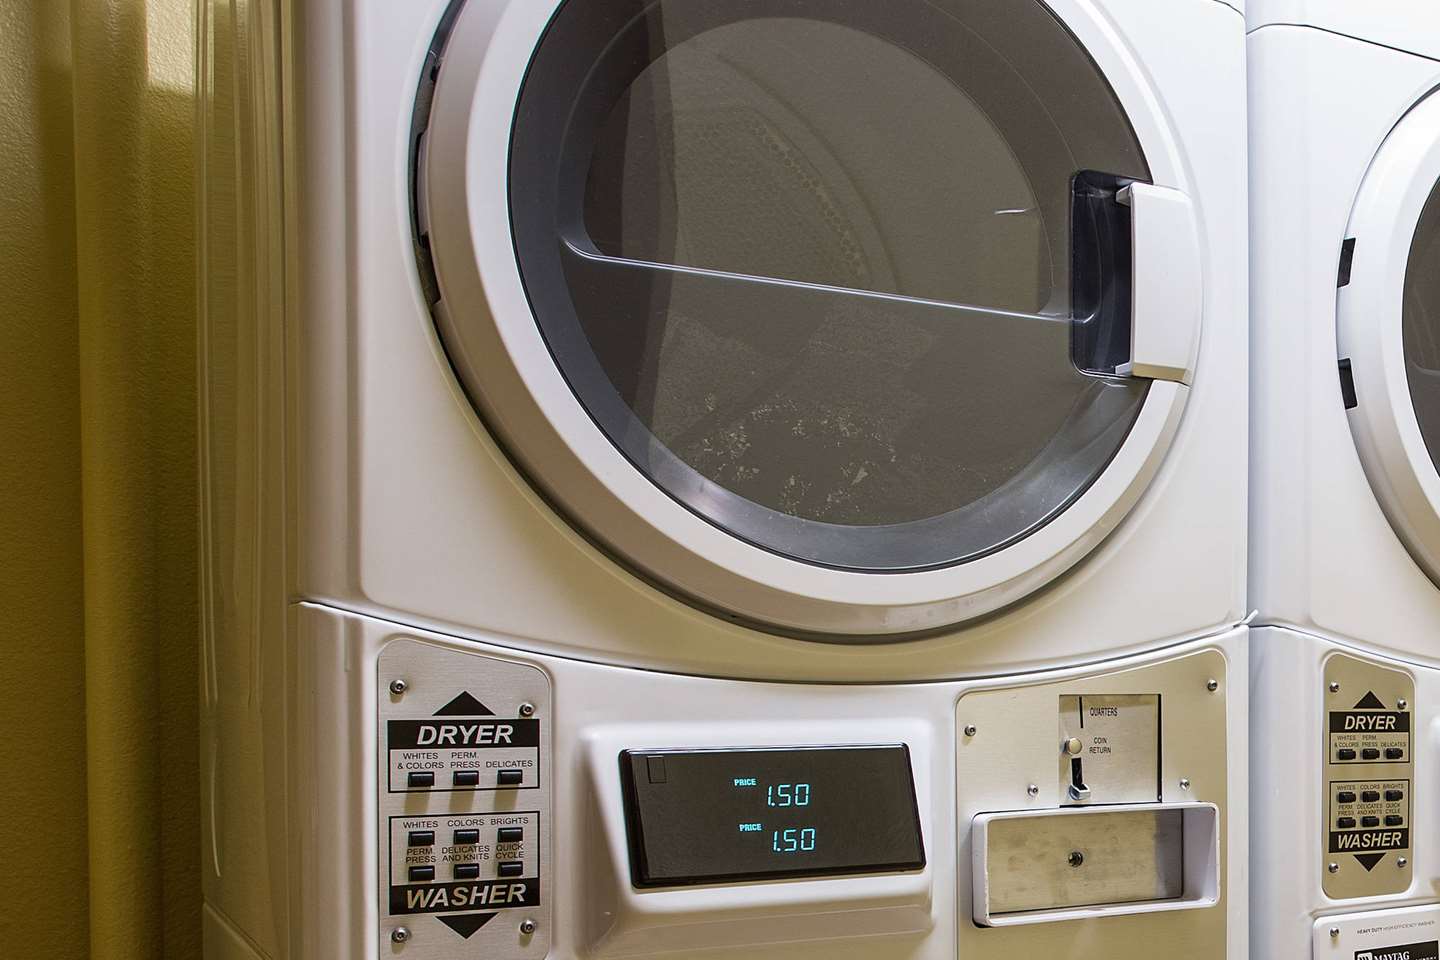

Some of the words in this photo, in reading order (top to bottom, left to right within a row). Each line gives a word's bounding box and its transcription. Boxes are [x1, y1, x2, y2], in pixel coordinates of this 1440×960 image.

[1090, 707, 1118, 716] QUARTERS
[1344, 715, 1396, 730] DRYER
[417, 725, 513, 745] DRYER
[403, 752, 439, 760] WHITES
[486, 760, 533, 768] DELICATES
[734, 778, 757, 786] PRICE
[767, 783, 810, 807] 1.50
[403, 821, 439, 829] WHITES
[447, 819, 485, 827] COLORS
[490, 817, 529, 825] BRIGHTS
[739, 823, 762, 832] PRICE
[772, 828, 816, 852] 1.50
[1338, 831, 1402, 849] WASHER
[441, 845, 490, 854] DELICATES
[496, 843, 524, 851] QUICK
[495, 851, 525, 859] CYCLE
[406, 883, 527, 909] WASHER
